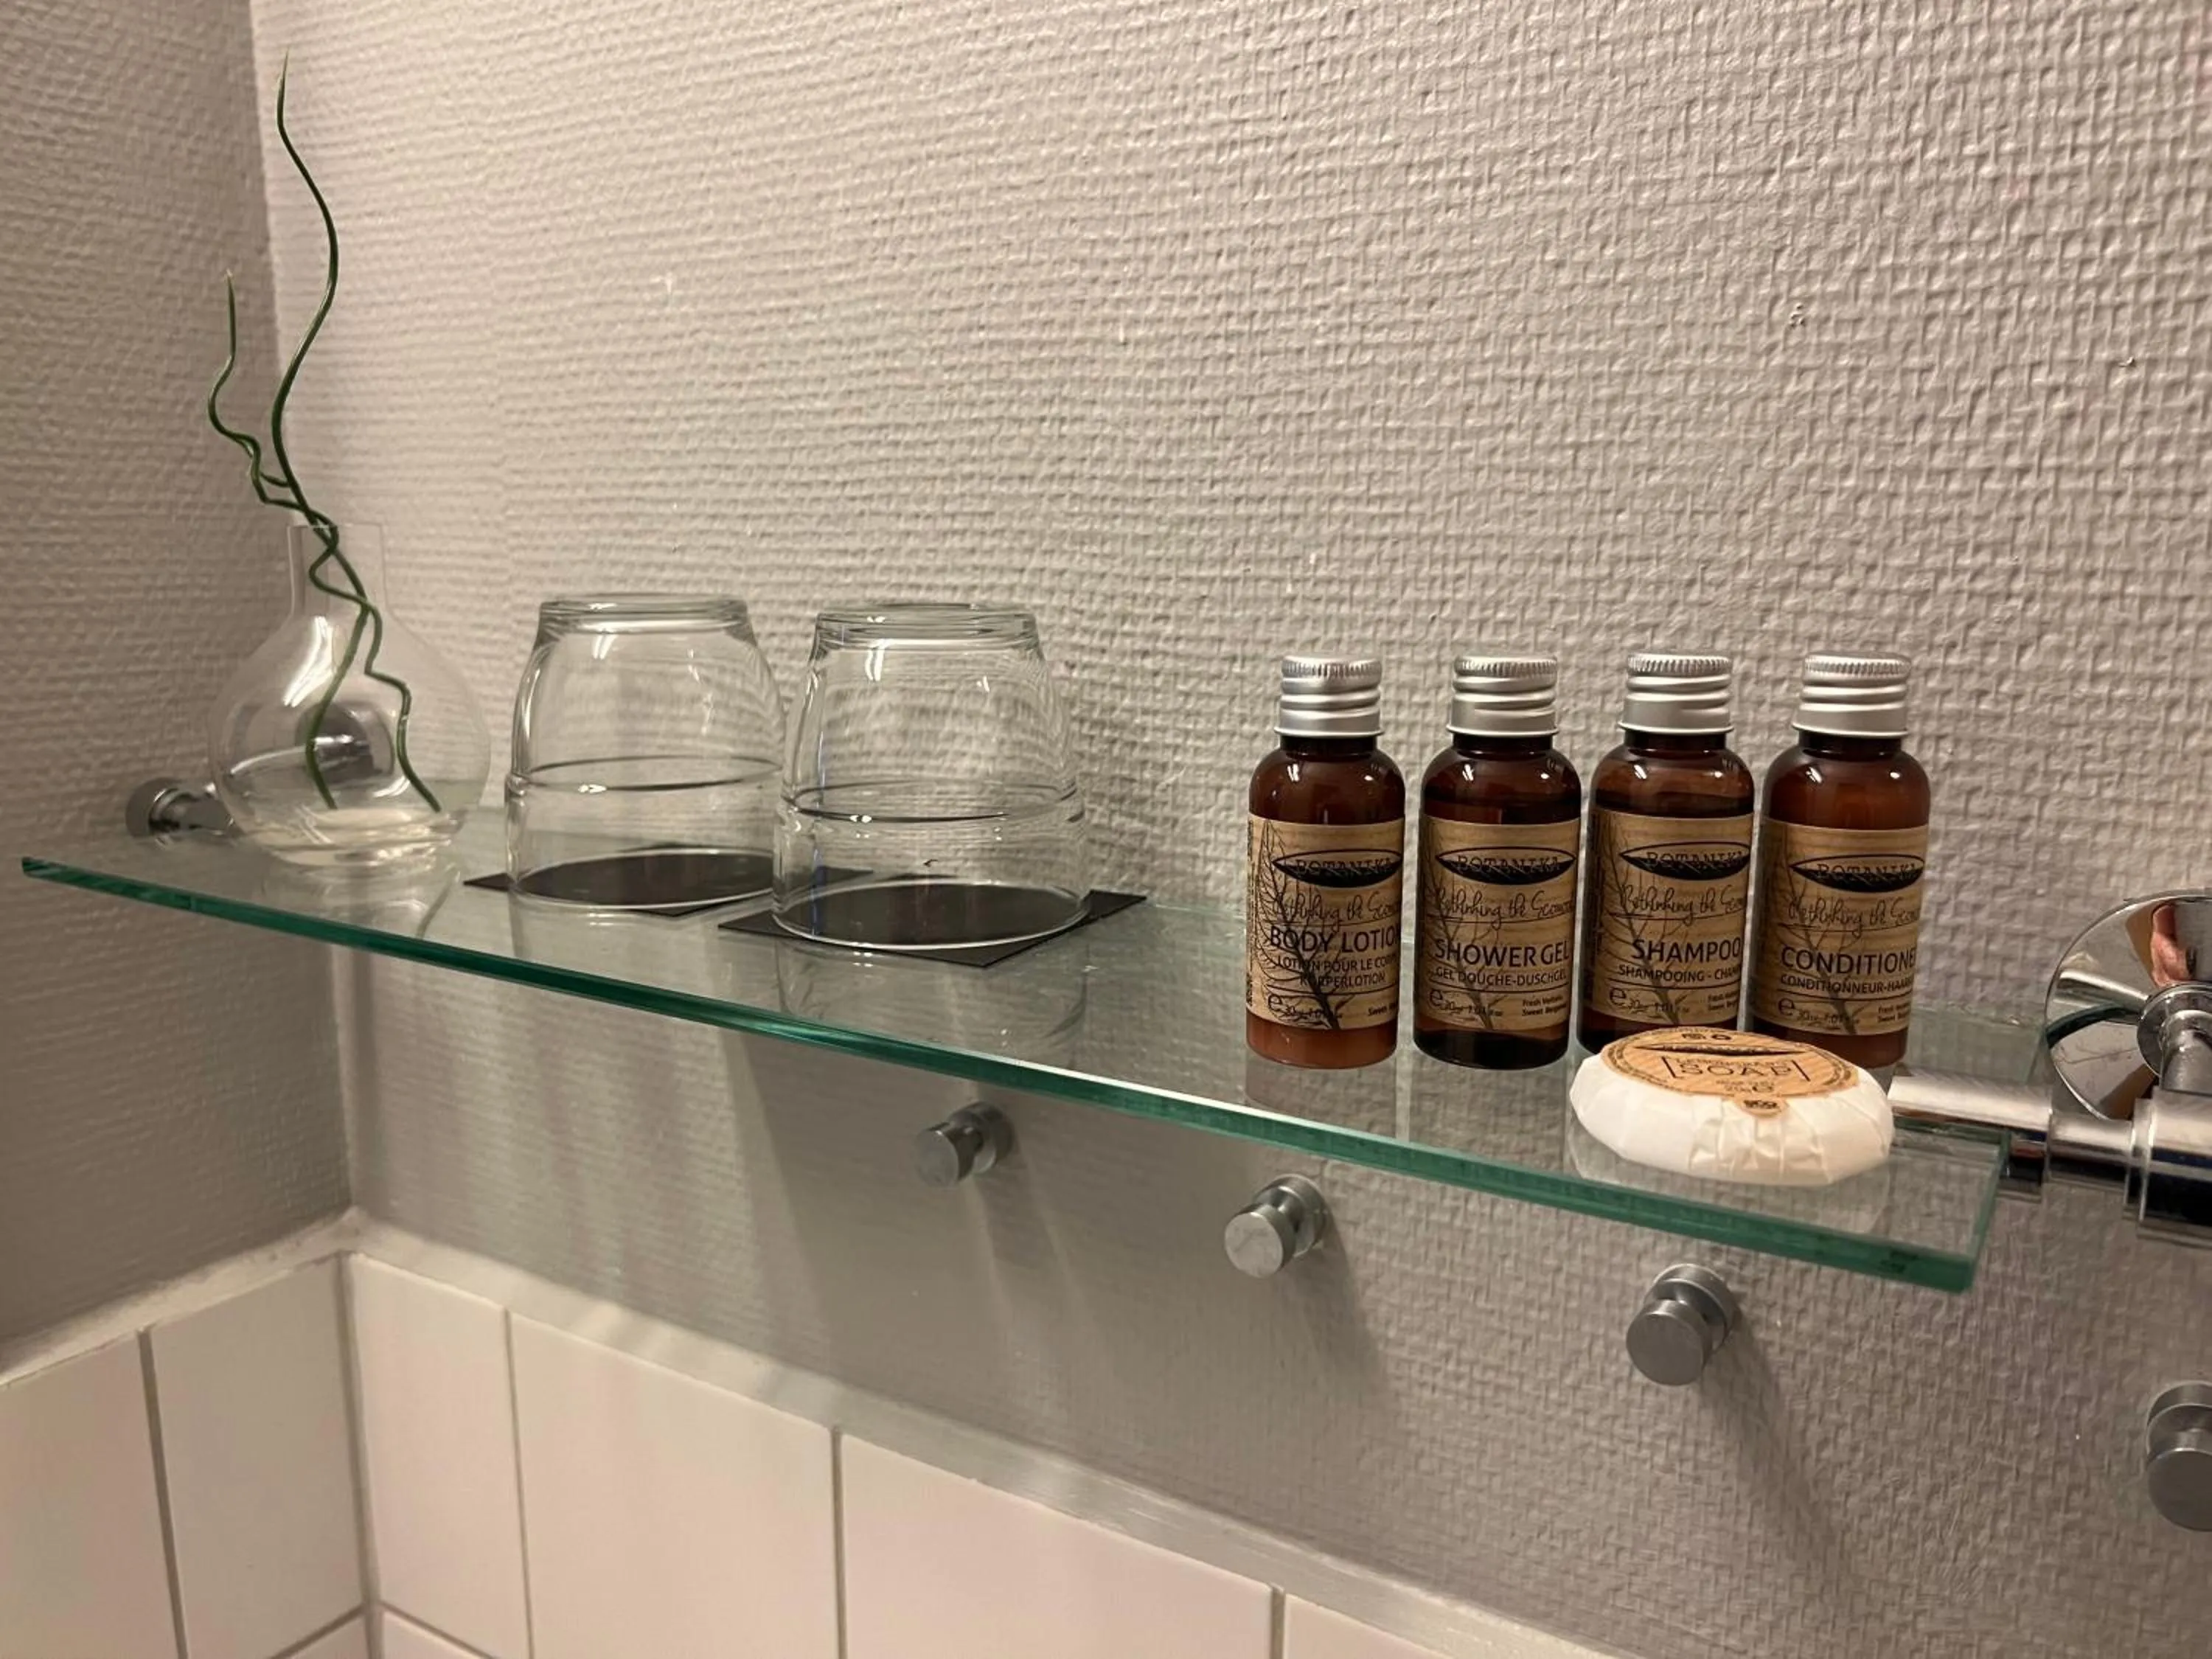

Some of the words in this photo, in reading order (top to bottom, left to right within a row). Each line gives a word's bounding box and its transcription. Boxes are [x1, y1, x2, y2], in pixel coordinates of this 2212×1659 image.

[1456, 855, 1562, 873] BOTANIKA
[1509, 893, 1526, 919] the
[1700, 887, 1716, 914] the
[1869, 899, 1886, 925] the
[1270, 926, 1332, 953] BODY
[1632, 937, 1741, 964] SHAMPOO
[1277, 956, 1320, 971] LOTIN
[1360, 959, 1374, 970] LE
[1435, 939, 1537, 968] SHOWER
[1540, 940, 1570, 965] GEL
[1781, 946, 1916, 975] CONDITIONE
[1437, 967, 1455, 981] GEL
[1618, 964, 1705, 984] SHAMPOOING
[1680, 1063, 1792, 1076] SOAP
